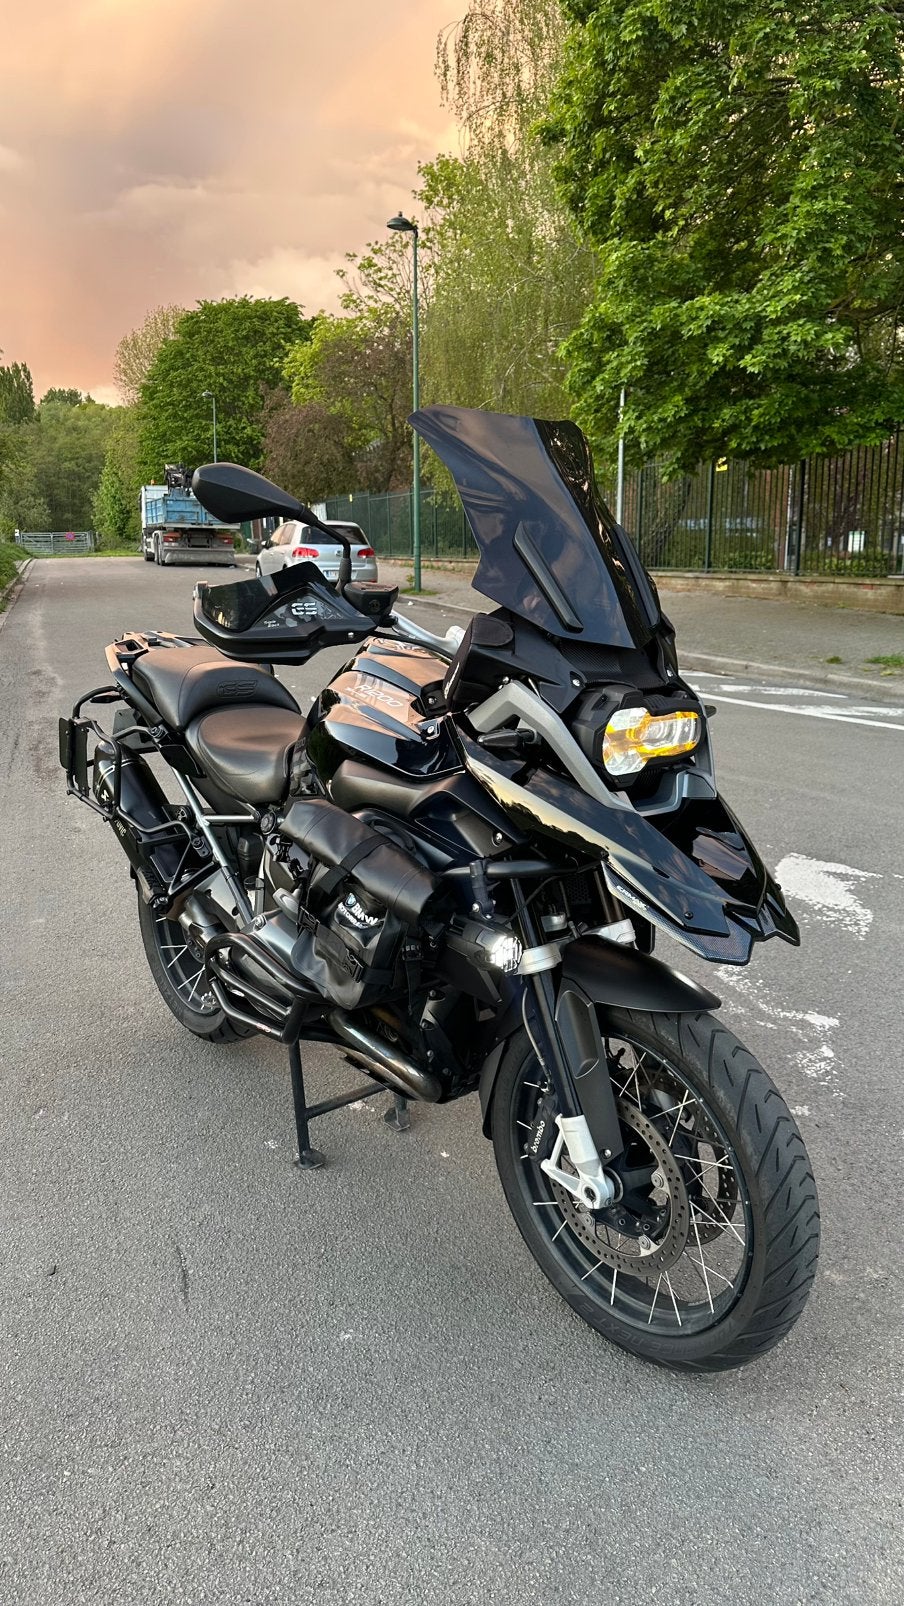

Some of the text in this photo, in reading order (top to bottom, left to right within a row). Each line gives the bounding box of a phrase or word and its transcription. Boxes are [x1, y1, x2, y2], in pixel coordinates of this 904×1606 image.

[291, 602, 317, 616] GS
[350, 902, 379, 926] BMW
[530, 1120, 546, 1154] brembo
